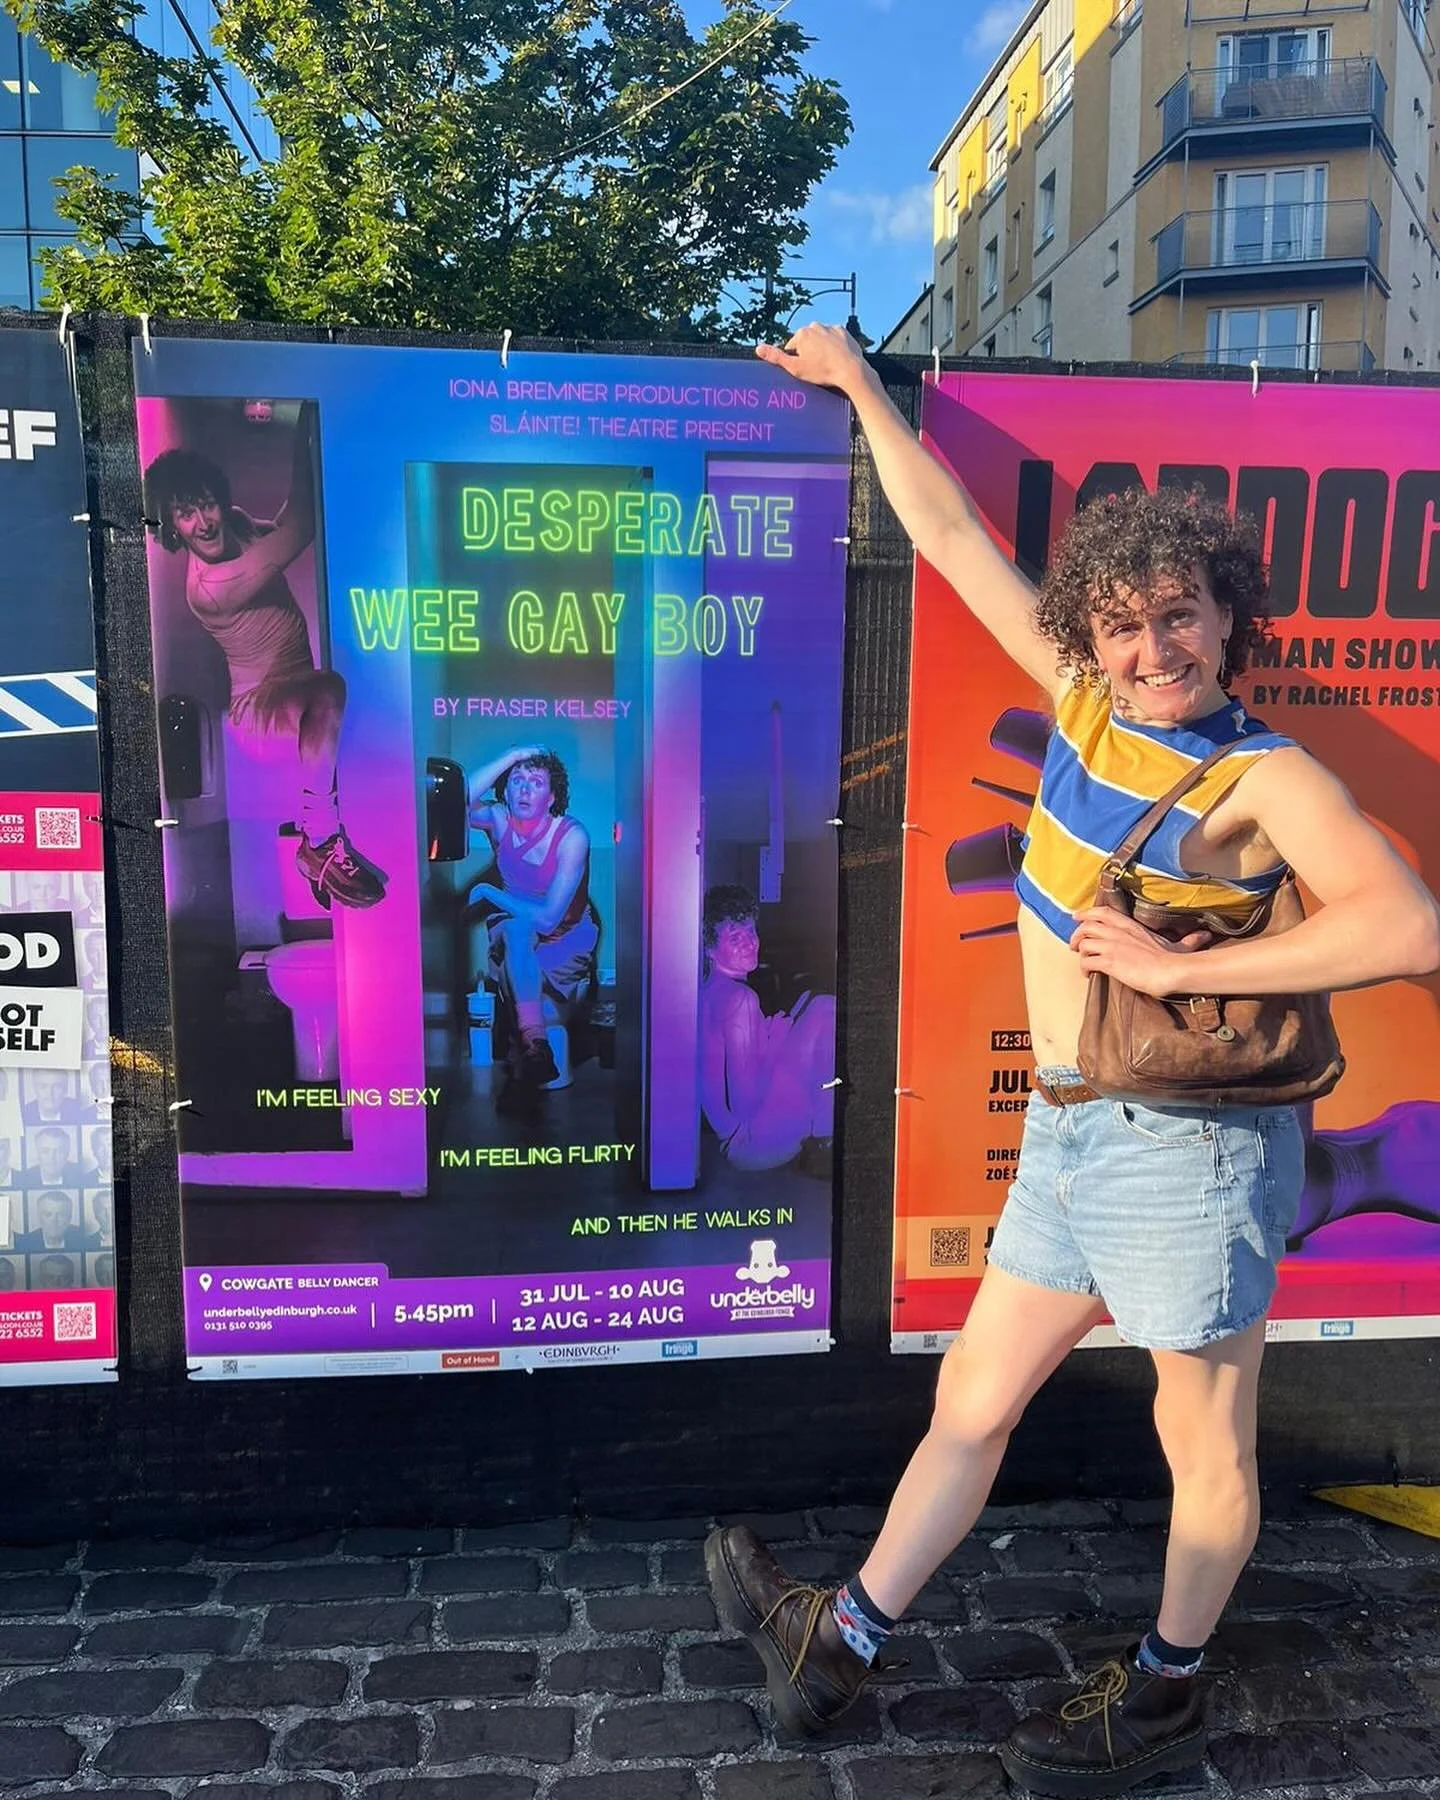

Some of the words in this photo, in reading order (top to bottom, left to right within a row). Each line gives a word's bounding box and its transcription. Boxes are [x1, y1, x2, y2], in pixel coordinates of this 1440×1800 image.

[450, 379, 499, 400] IONA
[507, 381, 608, 402] BREMNER
[616, 384, 759, 409] PRODUCTIONS
[767, 390, 806, 409] AND
[0, 409, 57, 460] F
[490, 410, 581, 436] SLÁINTE!
[588, 416, 678, 438] THEATRE
[685, 420, 775, 441] PRESENT
[462, 486, 794, 558] DESPERATE
[350, 588, 481, 652] WEE
[508, 590, 625, 655] GAY
[654, 594, 764, 657] BOY
[1253, 685, 1282, 705] BY
[1288, 686, 1372, 706] RACHEL
[1379, 686, 1440, 706] FROS
[433, 698, 460, 717] BY
[467, 698, 548, 718] FRASER
[554, 699, 632, 719] KELSEY
[1, 1003, 43, 1027] OT
[995, 1034, 1031, 1047] 12:30
[990, 1070, 1032, 1094] JUL
[256, 1089, 287, 1107] I'M
[293, 1088, 382, 1108] FEELING
[388, 1087, 441, 1107] SEXY
[440, 1149, 470, 1168] I'M
[476, 1147, 563, 1167] FEELING
[568, 1144, 636, 1165] FLIRTY
[986, 1165, 1010, 1180] ZOÉ
[571, 1216, 611, 1236] AND
[618, 1214, 668, 1234] THEN
[673, 1212, 698, 1230] HE
[706, 1209, 772, 1229] WALKS
[777, 1207, 794, 1226] IN
[221, 1277, 293, 1291] COWGATE
[298, 1278, 332, 1289] BELLY
[333, 1277, 379, 1288] DANCER
[520, 1288, 544, 1306] 31
[549, 1284, 590, 1303] JUL
[609, 1284, 633, 1299] 10
[638, 1278, 685, 1298] AUG
[710, 1283, 815, 1309] underbelly
[204, 1304, 358, 1319] underbellyedinburgh.co.uk
[394, 1303, 474, 1323] 5.45pm
[512, 1316, 536, 1332] 12
[541, 1310, 588, 1330] AUG
[608, 1310, 633, 1329] 24
[638, 1306, 684, 1325] AUG
[16, 1328, 43, 1338] 6552
[204, 1322, 227, 1331] 0131
[229, 1321, 246, 1331] 510
[248, 1321, 273, 1331] 0395
